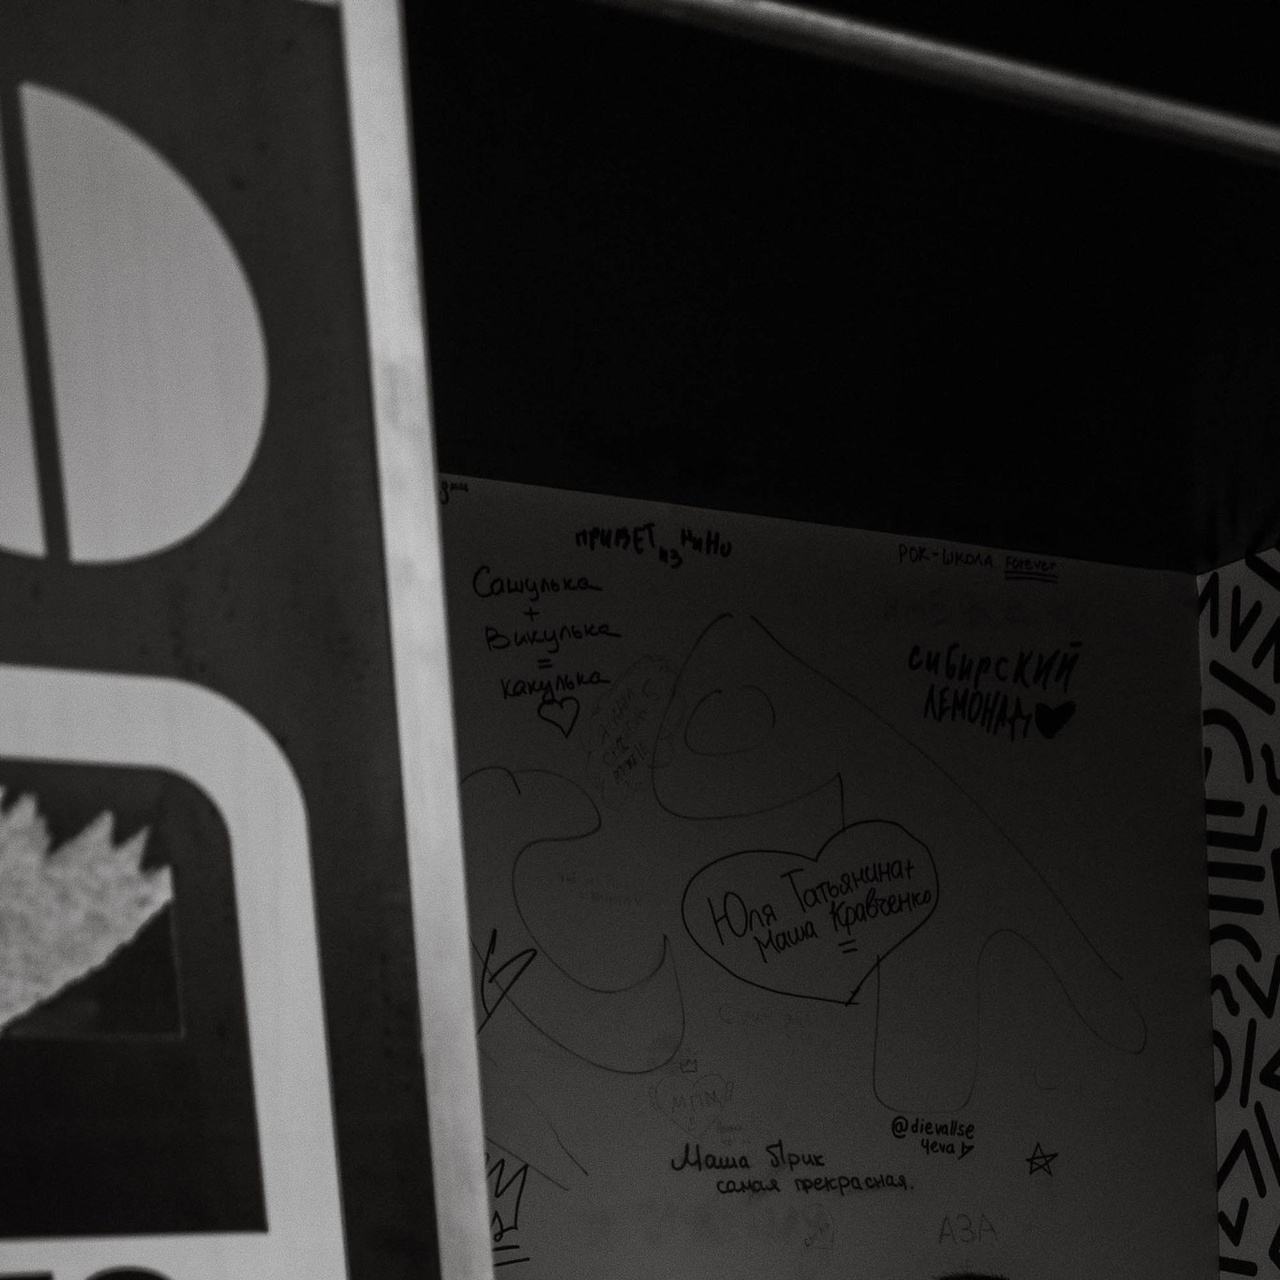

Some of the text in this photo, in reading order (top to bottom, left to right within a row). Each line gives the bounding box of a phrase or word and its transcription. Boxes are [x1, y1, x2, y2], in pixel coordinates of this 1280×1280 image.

[472, 565, 603, 601] Сашулька
[485, 624, 622, 654] Викулька
[923, 683, 1034, 742] ЛЕМОНАД
[707, 891, 777, 946] Юля
[671, 1142, 750, 1172] Маша
[716, 1177, 781, 1195] самая
